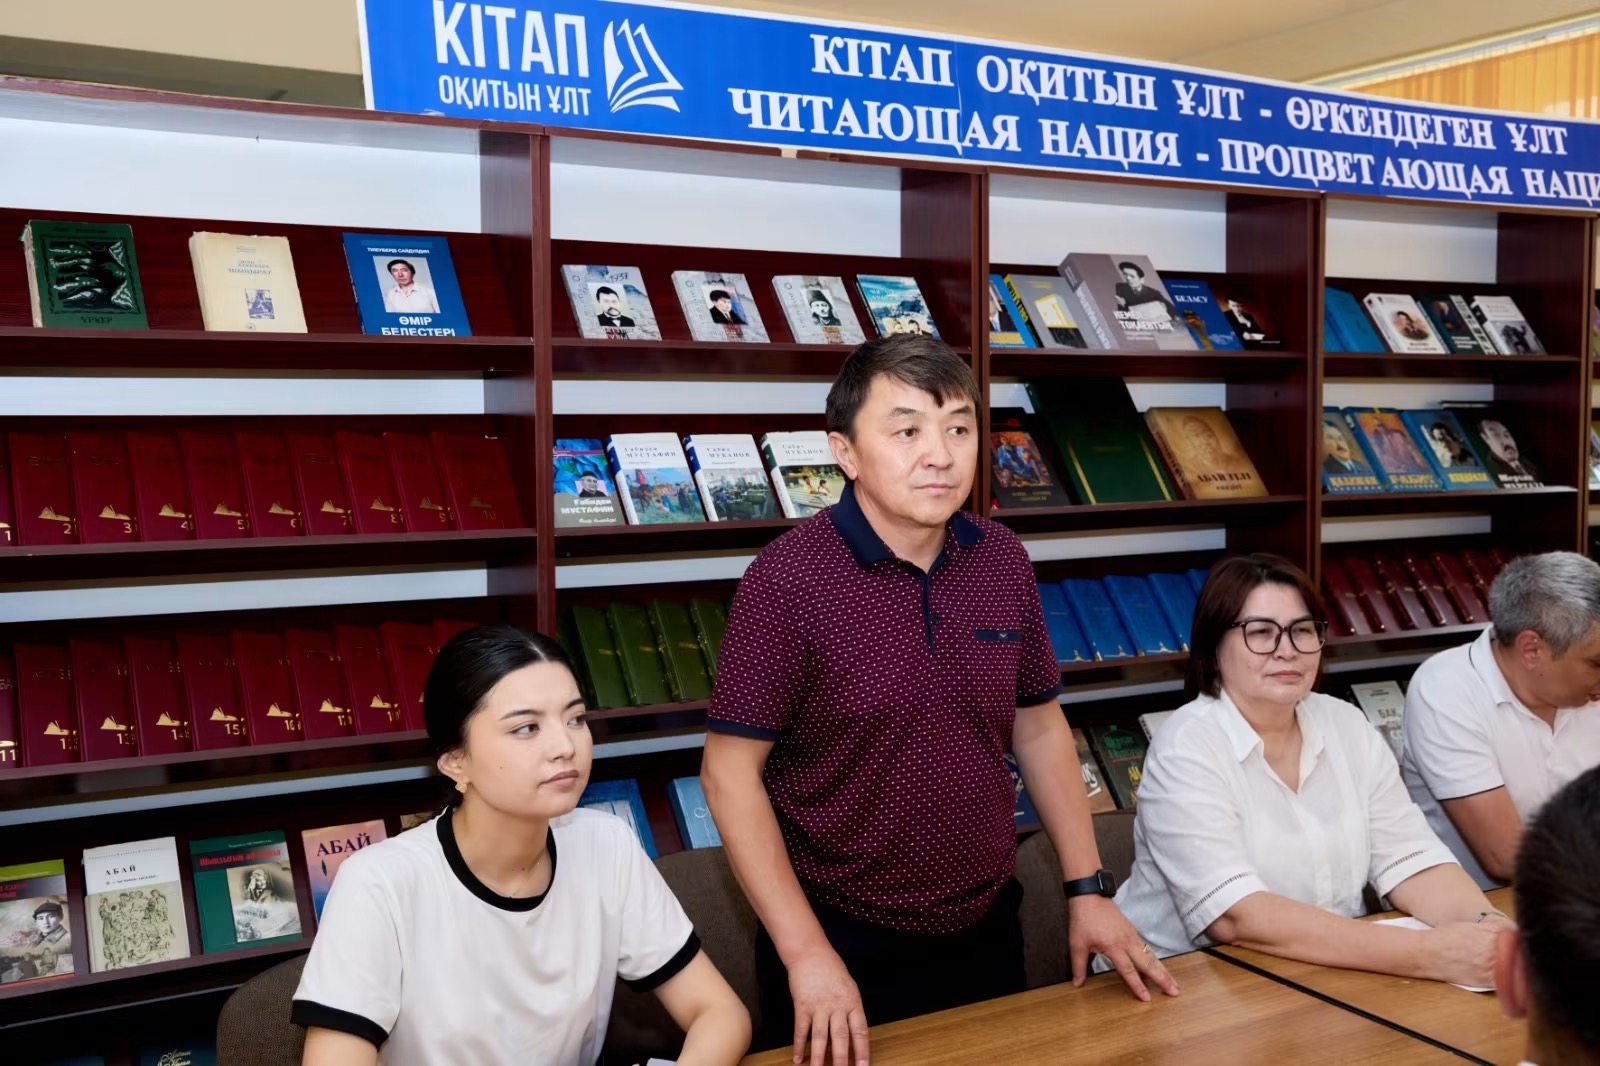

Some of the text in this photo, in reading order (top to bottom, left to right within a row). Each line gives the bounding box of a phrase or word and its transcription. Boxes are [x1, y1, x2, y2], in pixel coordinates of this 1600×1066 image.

[432, 0, 590, 78] КІТАП
[438, 74, 592, 117] ОҚИТЫН ҰЛТ
[809, 33, 955, 87] КІТАП
[976, 54, 1159, 111] ОҚИТЫН
[1171, 78, 1245, 122] ҰЛТ
[1285, 96, 1497, 150] ӨРКЕНДЕГЕН
[1505, 121, 1569, 155] ҰЛТ
[727, 87, 1022, 156] ЧИТАЮЩАЯ
[1037, 118, 1182, 171] НАЦИЯ
[398, 316, 433, 326] ӨМІР
[63, 523, 72, 534] 2
[123, 522, 133, 534] 3
[316, 832, 371, 857] АБАЙ
[105, 864, 136, 877] АБАЙ
